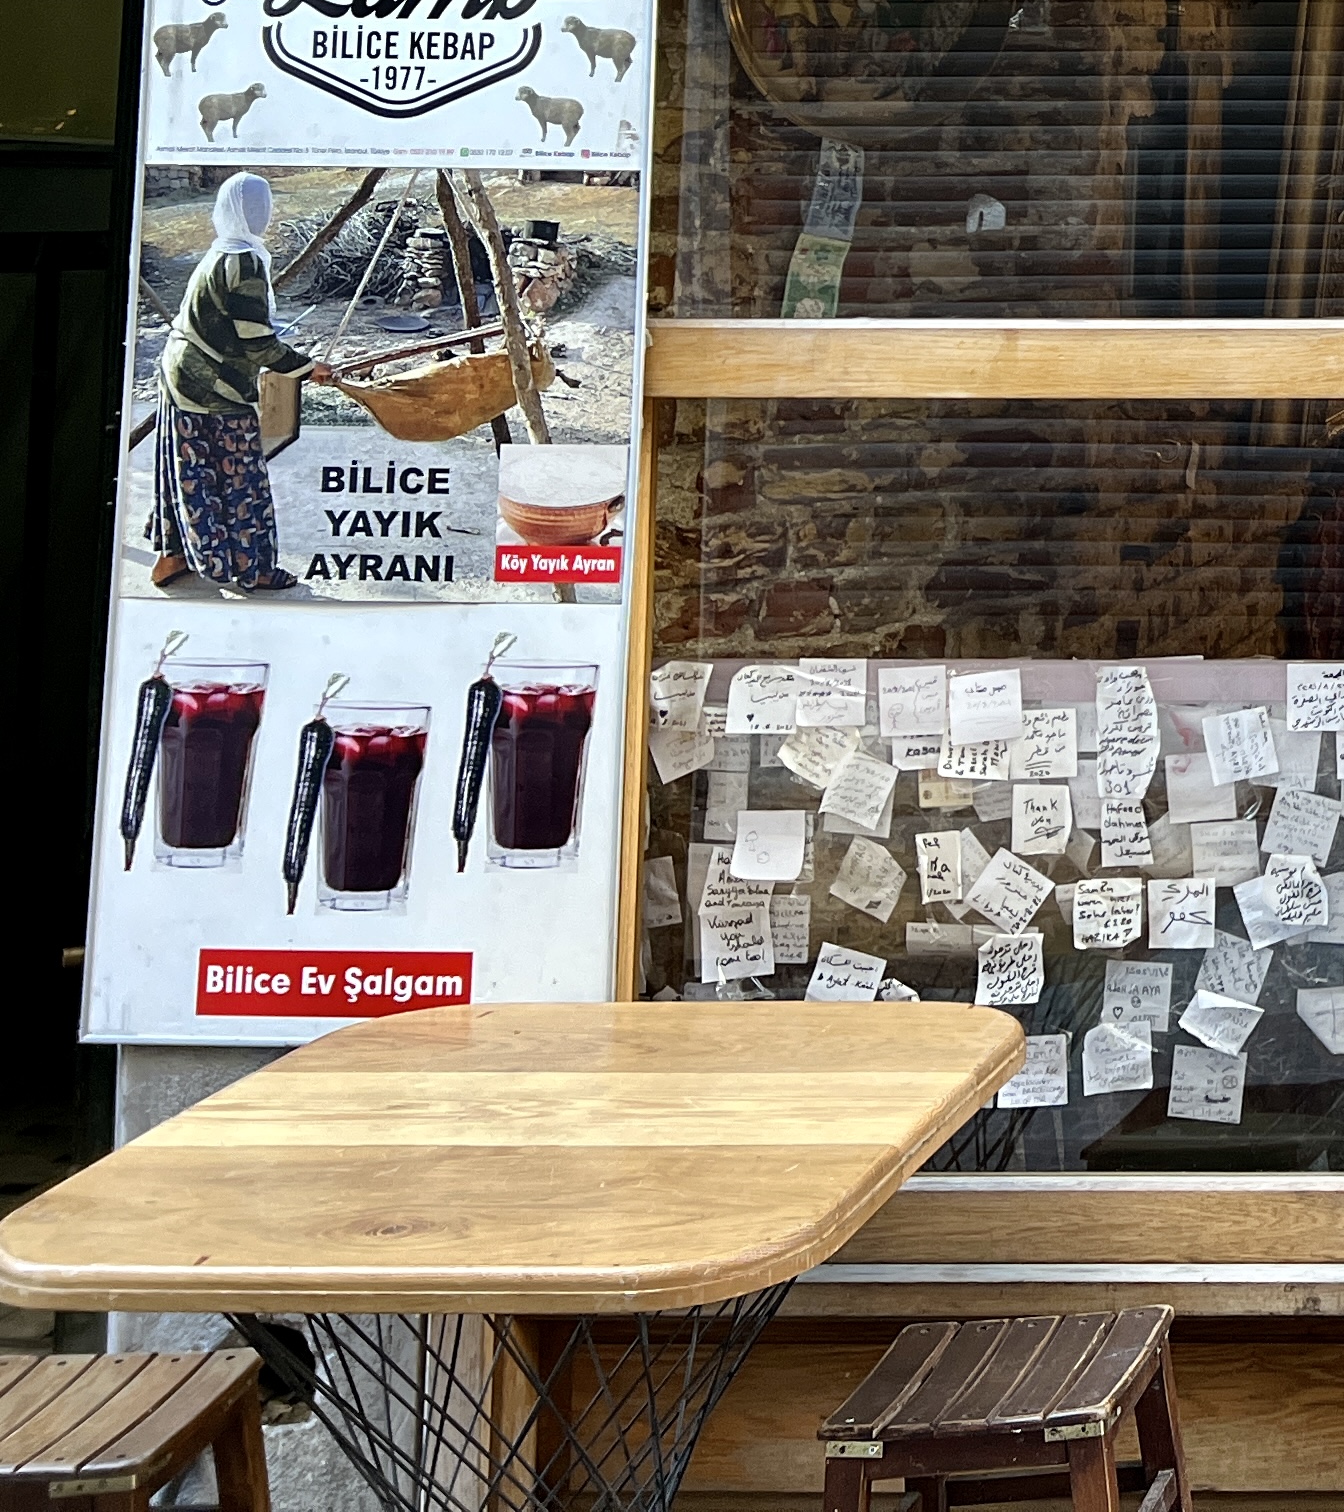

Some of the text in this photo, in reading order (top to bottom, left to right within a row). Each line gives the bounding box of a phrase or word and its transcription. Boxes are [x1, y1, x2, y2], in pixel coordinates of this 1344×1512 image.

[311, 24, 496, 61] BİLİCE KEBAP
[320, 459, 451, 495] BİLİCE
[324, 510, 443, 539] YAYIK
[304, 553, 455, 584] AYRANI
[500, 552, 616, 576] Köy Yayık Ayran
[204, 963, 464, 1005] Bilice Ev Şalgam
